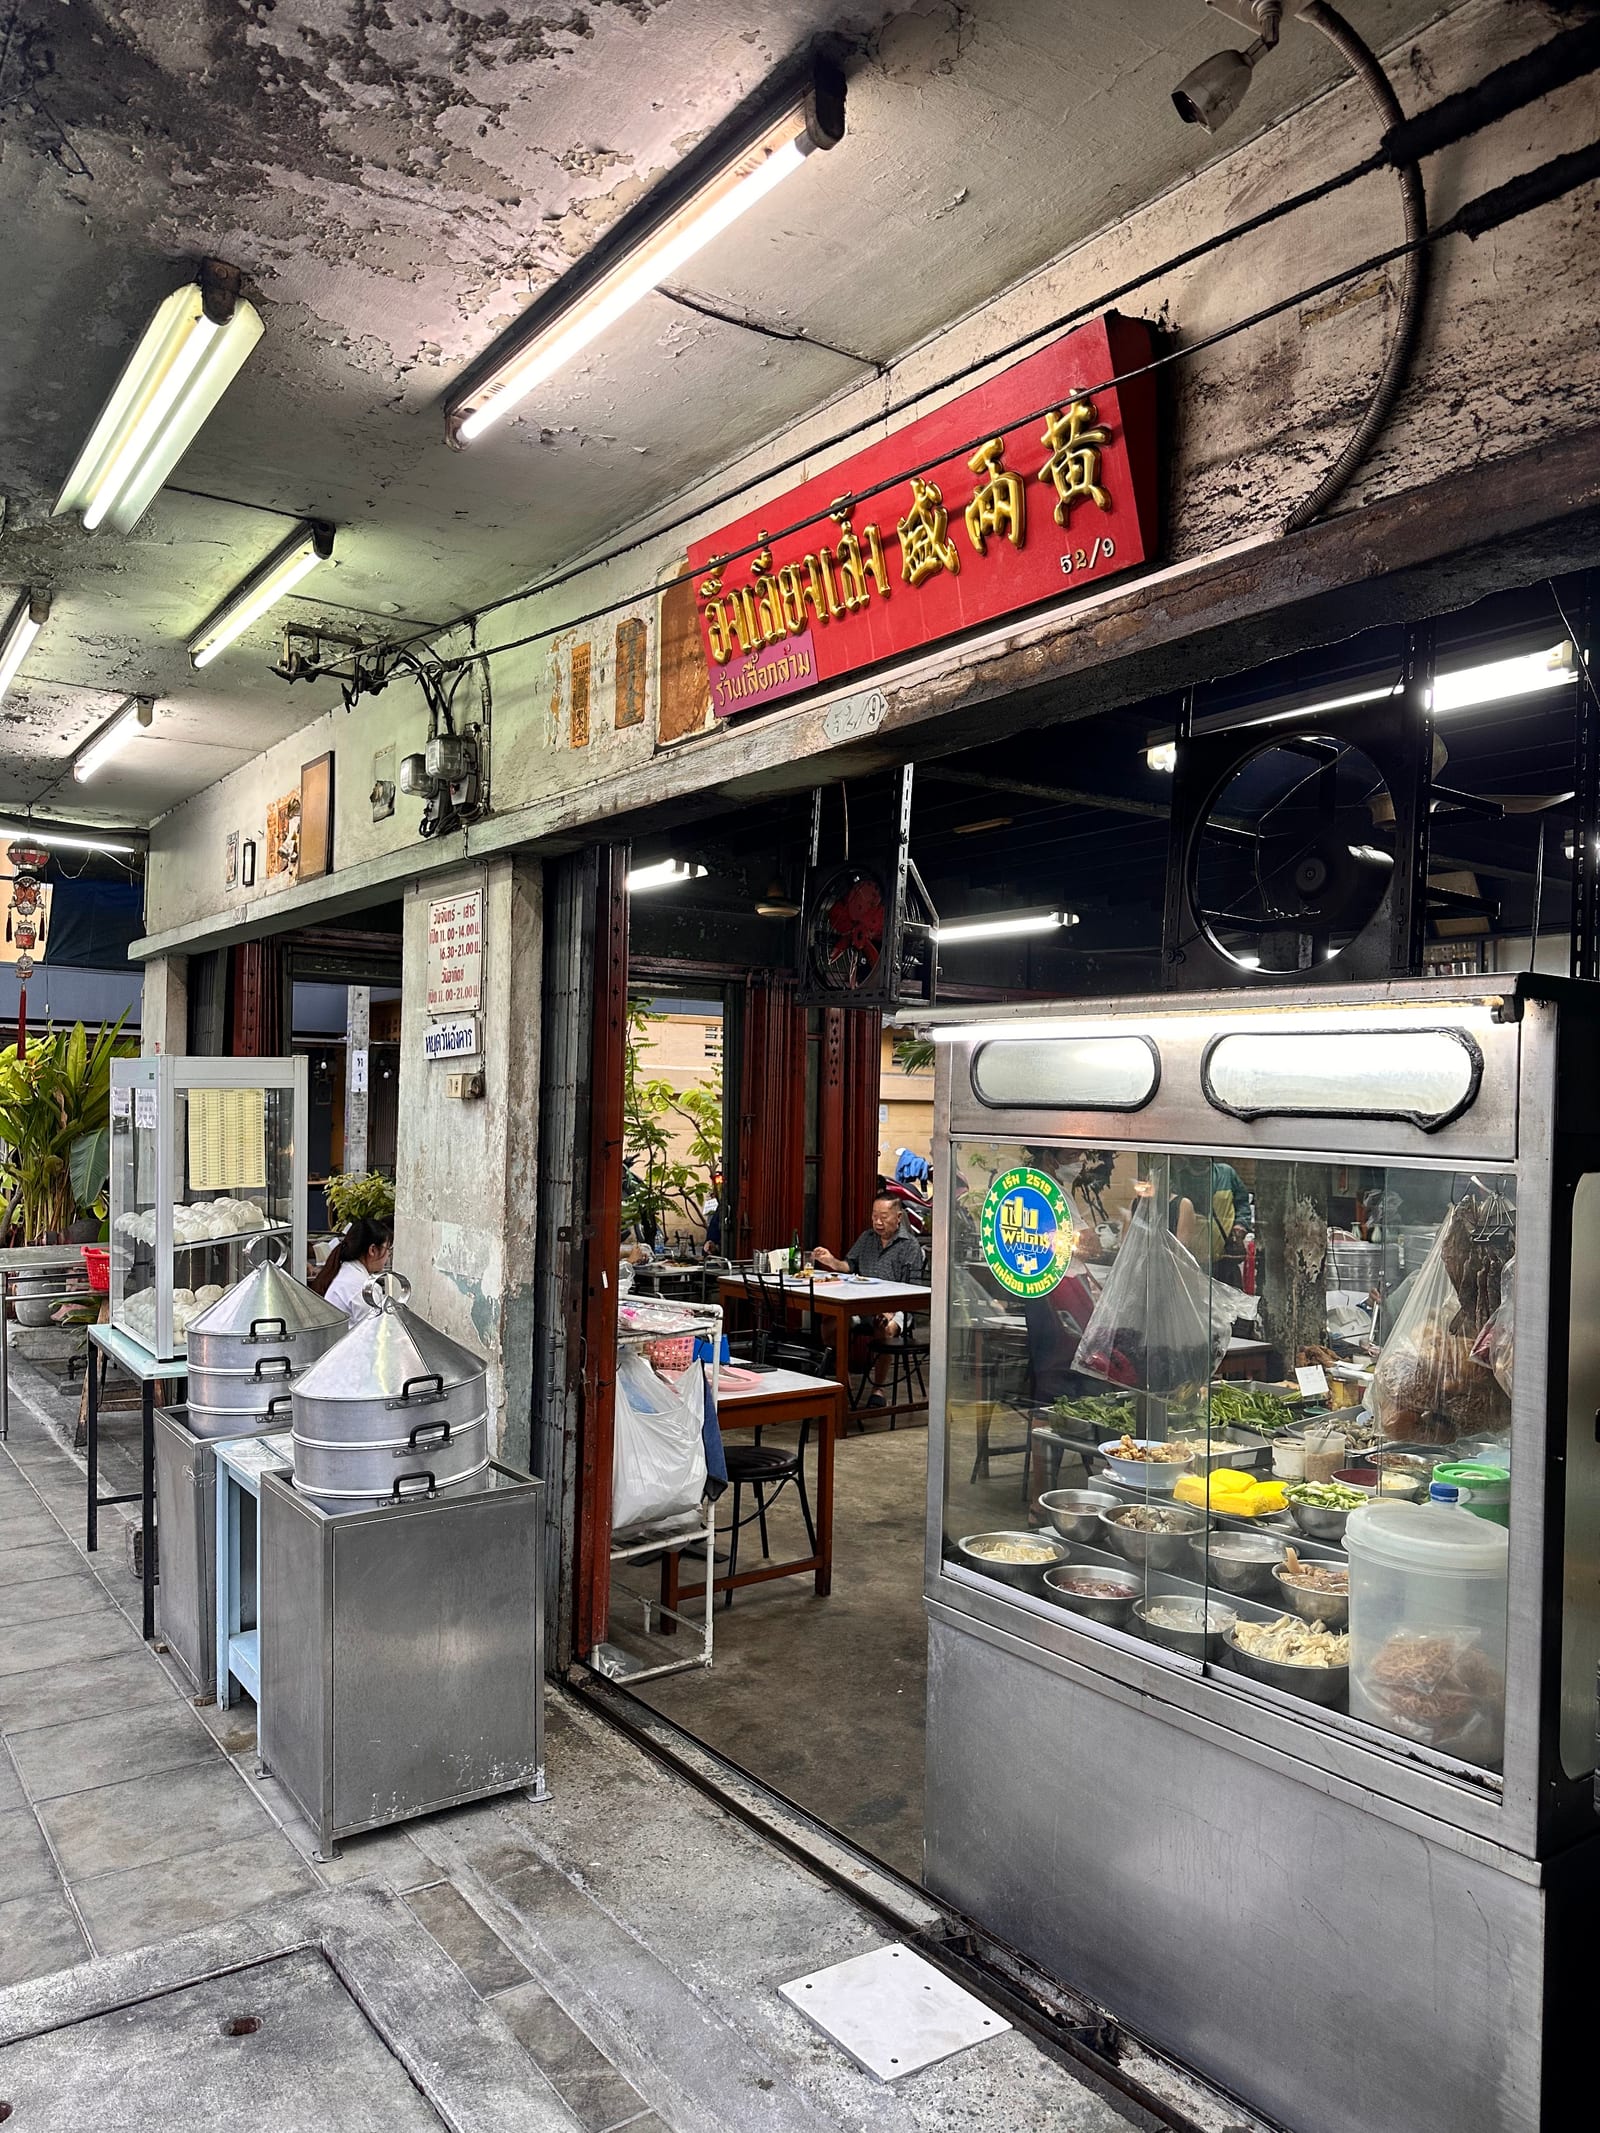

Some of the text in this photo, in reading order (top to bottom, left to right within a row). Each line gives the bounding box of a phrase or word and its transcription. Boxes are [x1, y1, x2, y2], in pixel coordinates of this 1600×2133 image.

[1060, 538, 1115, 574] 52/9
[832, 692, 882, 737] 52/9
[433, 903, 455, 925] วันจันทร์
[463, 898, 476, 919] เสาร์
[441, 963, 464, 984] วันอาทิตย์
[425, 1023, 473, 1058] หยุดวันอังคาร
[1026, 1173, 1052, 1196] 2519
